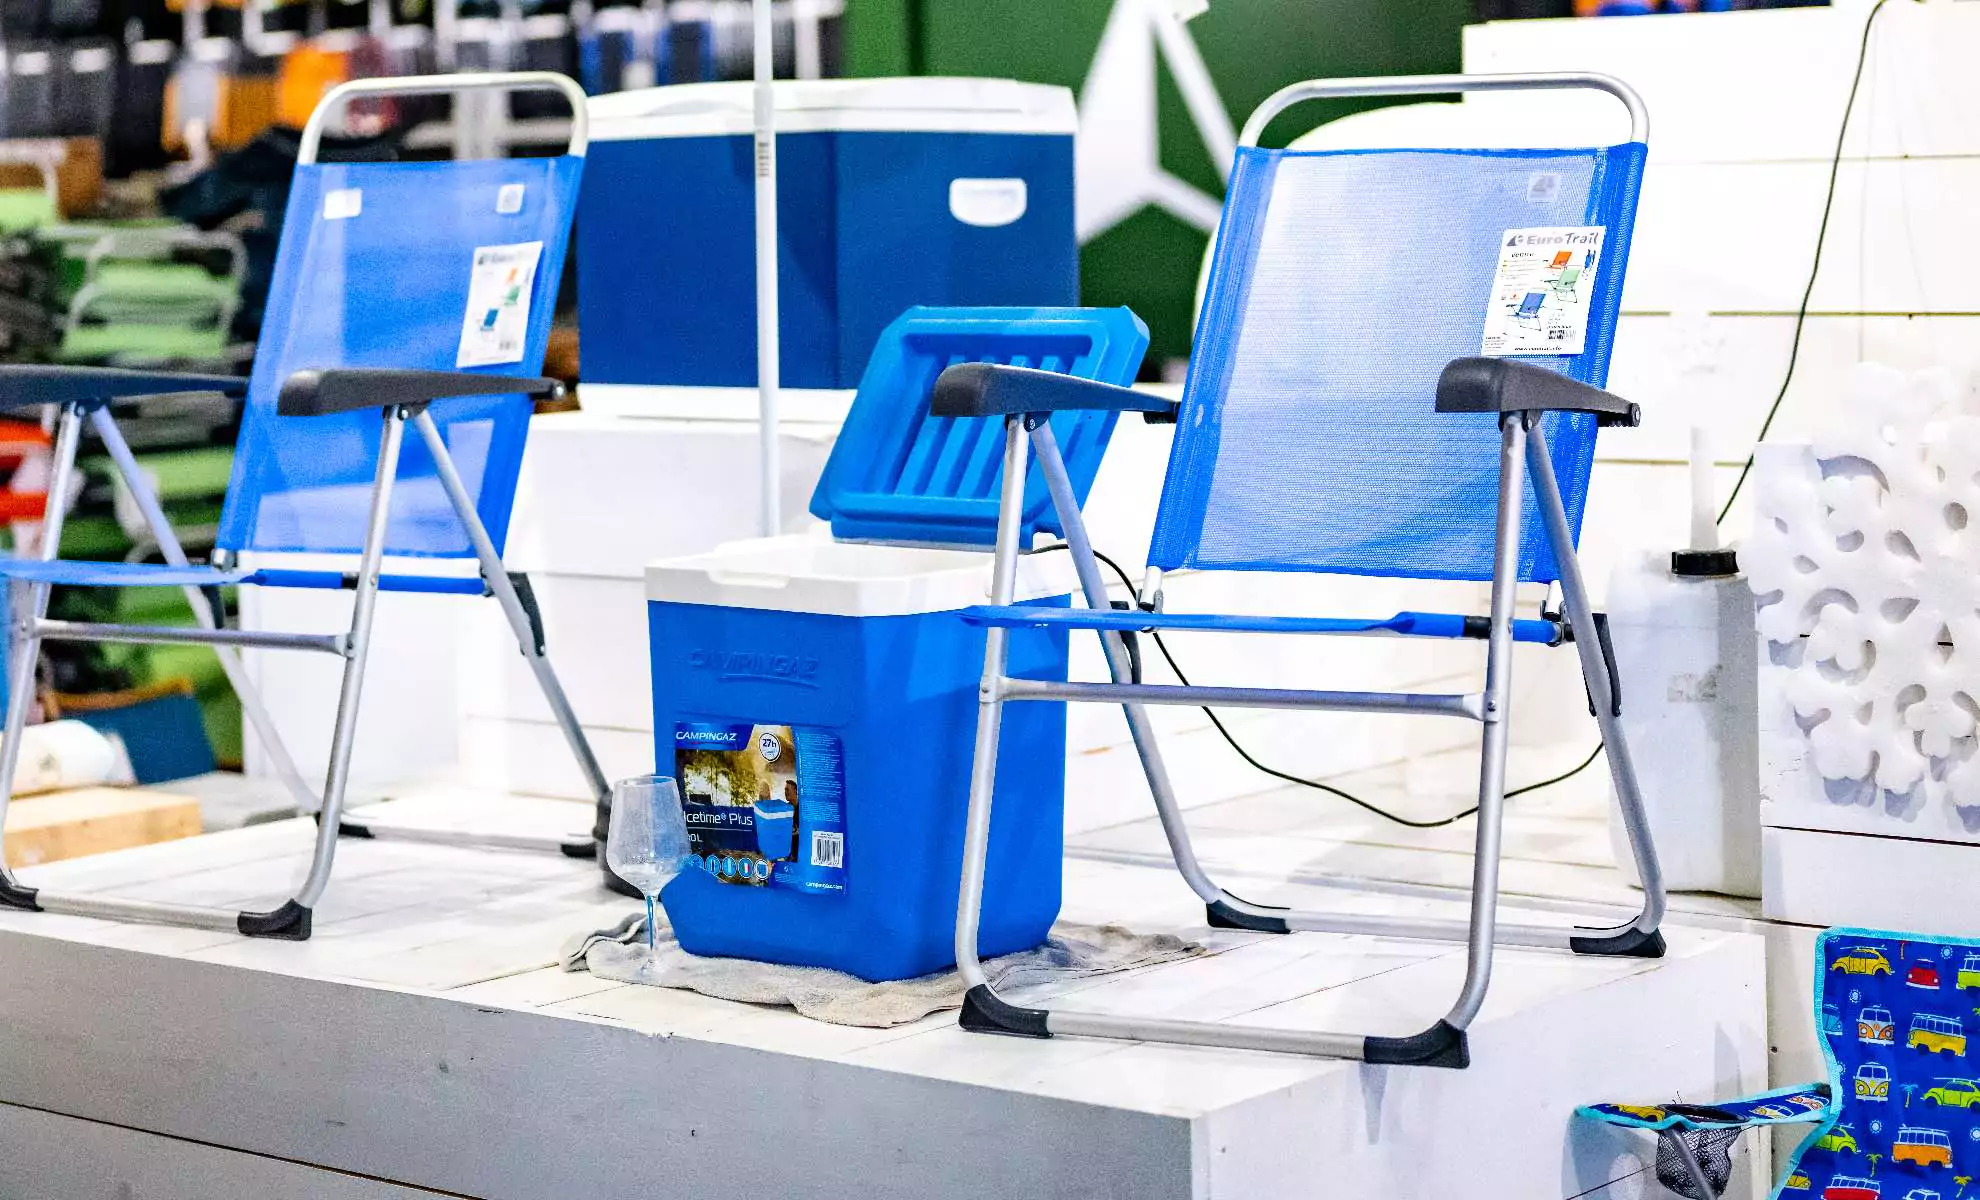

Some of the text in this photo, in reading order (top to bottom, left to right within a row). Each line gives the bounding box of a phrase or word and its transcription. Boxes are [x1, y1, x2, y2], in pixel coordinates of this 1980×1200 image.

[675, 731, 738, 741] CAMPINGAZ
[762, 738, 777, 748] 27h
[728, 812, 753, 826] Plus
